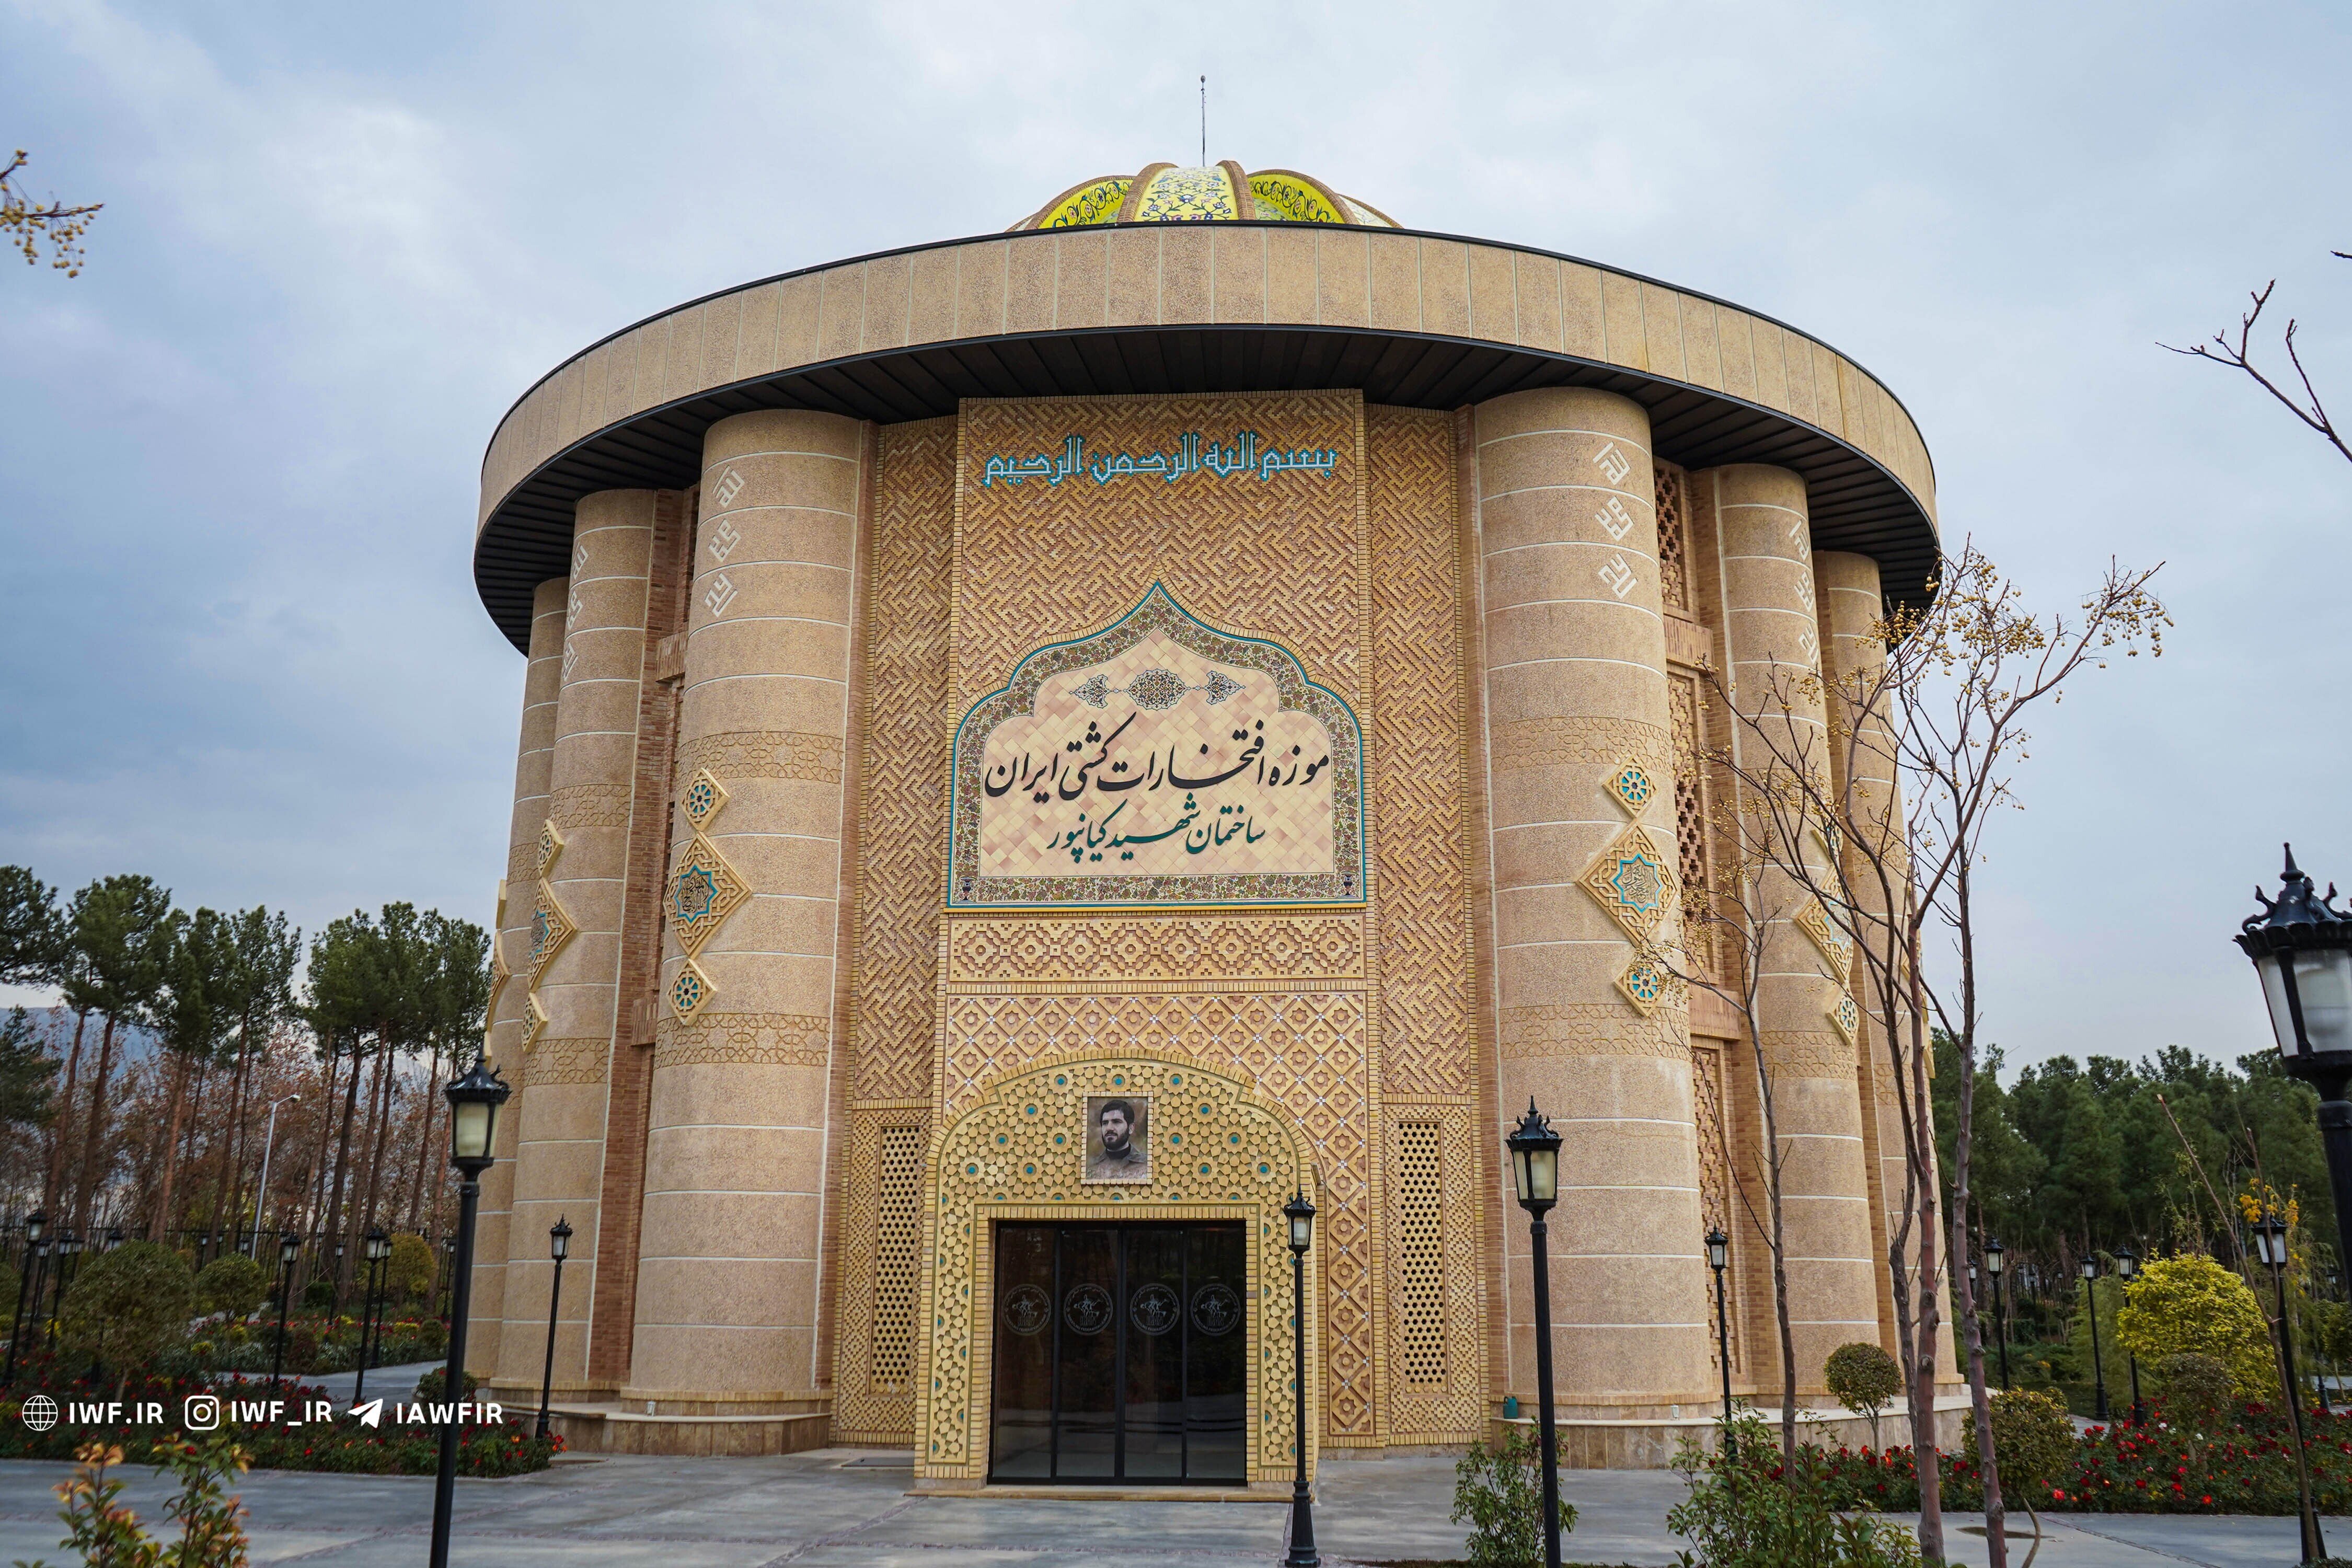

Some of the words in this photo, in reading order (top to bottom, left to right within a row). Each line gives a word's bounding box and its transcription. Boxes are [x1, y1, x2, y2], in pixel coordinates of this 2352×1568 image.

[1090, 432, 1200, 486] الرحمن
[1202, 431, 1259, 479] الله
[1260, 448, 1336, 481] بسم
[985, 752, 1058, 804] ایران
[1059, 711, 1137, 801] کشتی
[1097, 720, 1264, 792] افتخارات
[1269, 745, 1329, 787] موزه
[1046, 798, 1128, 864] کیانپور
[1104, 792, 1201, 861] شهید
[1185, 804, 1265, 855] ساختمان
